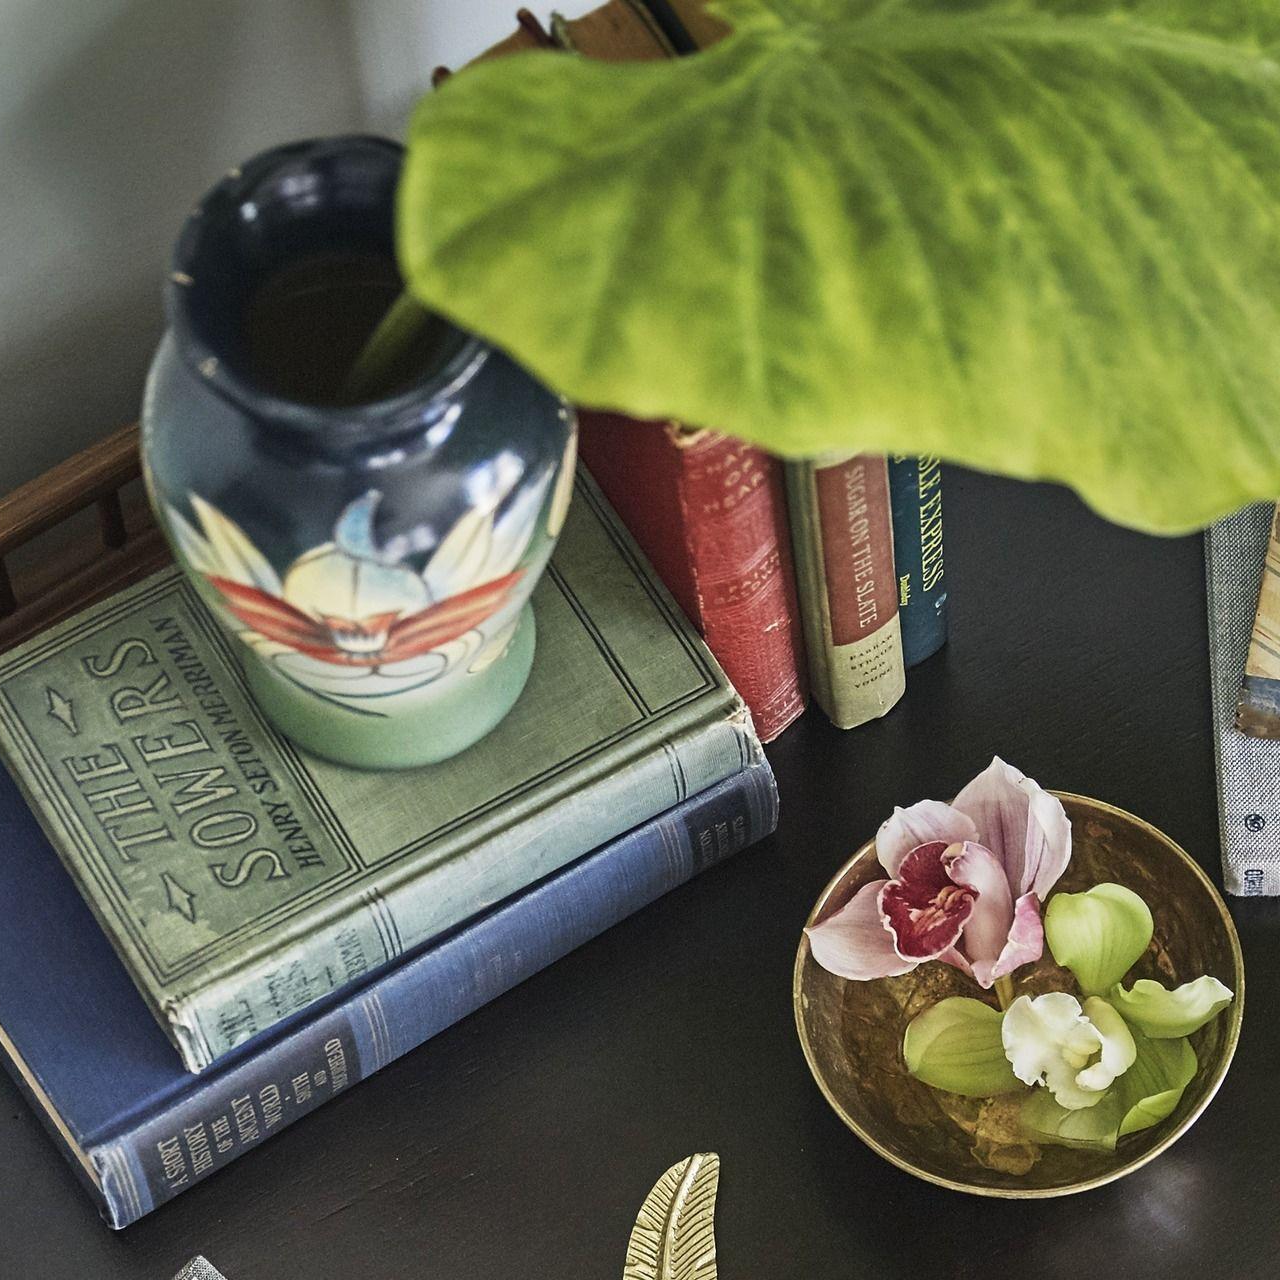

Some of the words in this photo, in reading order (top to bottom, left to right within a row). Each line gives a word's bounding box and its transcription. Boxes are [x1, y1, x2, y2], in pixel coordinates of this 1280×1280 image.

[844, 464, 867, 522] SUGAR
[849, 518, 869, 547] ON
[920, 489, 944, 592] EXPRESS
[852, 544, 873, 582] THE
[856, 579, 878, 628] SLATE
[149, 616, 233, 727] MERRIMAN
[81, 636, 292, 888] SOWERS
[220, 729, 279, 794] SETON
[61, 742, 176, 864] THE
[261, 798, 326, 870] HENRY
[211, 1115, 231, 1139] THE
[231, 1094, 260, 1144] ANCIENT
[259, 1084, 283, 1129] WORLD
[157, 1135, 186, 1182] SHORT
[183, 1121, 214, 1176] HISTORY
[218, 1139, 234, 1154] OF
[170, 1174, 189, 1188] A
